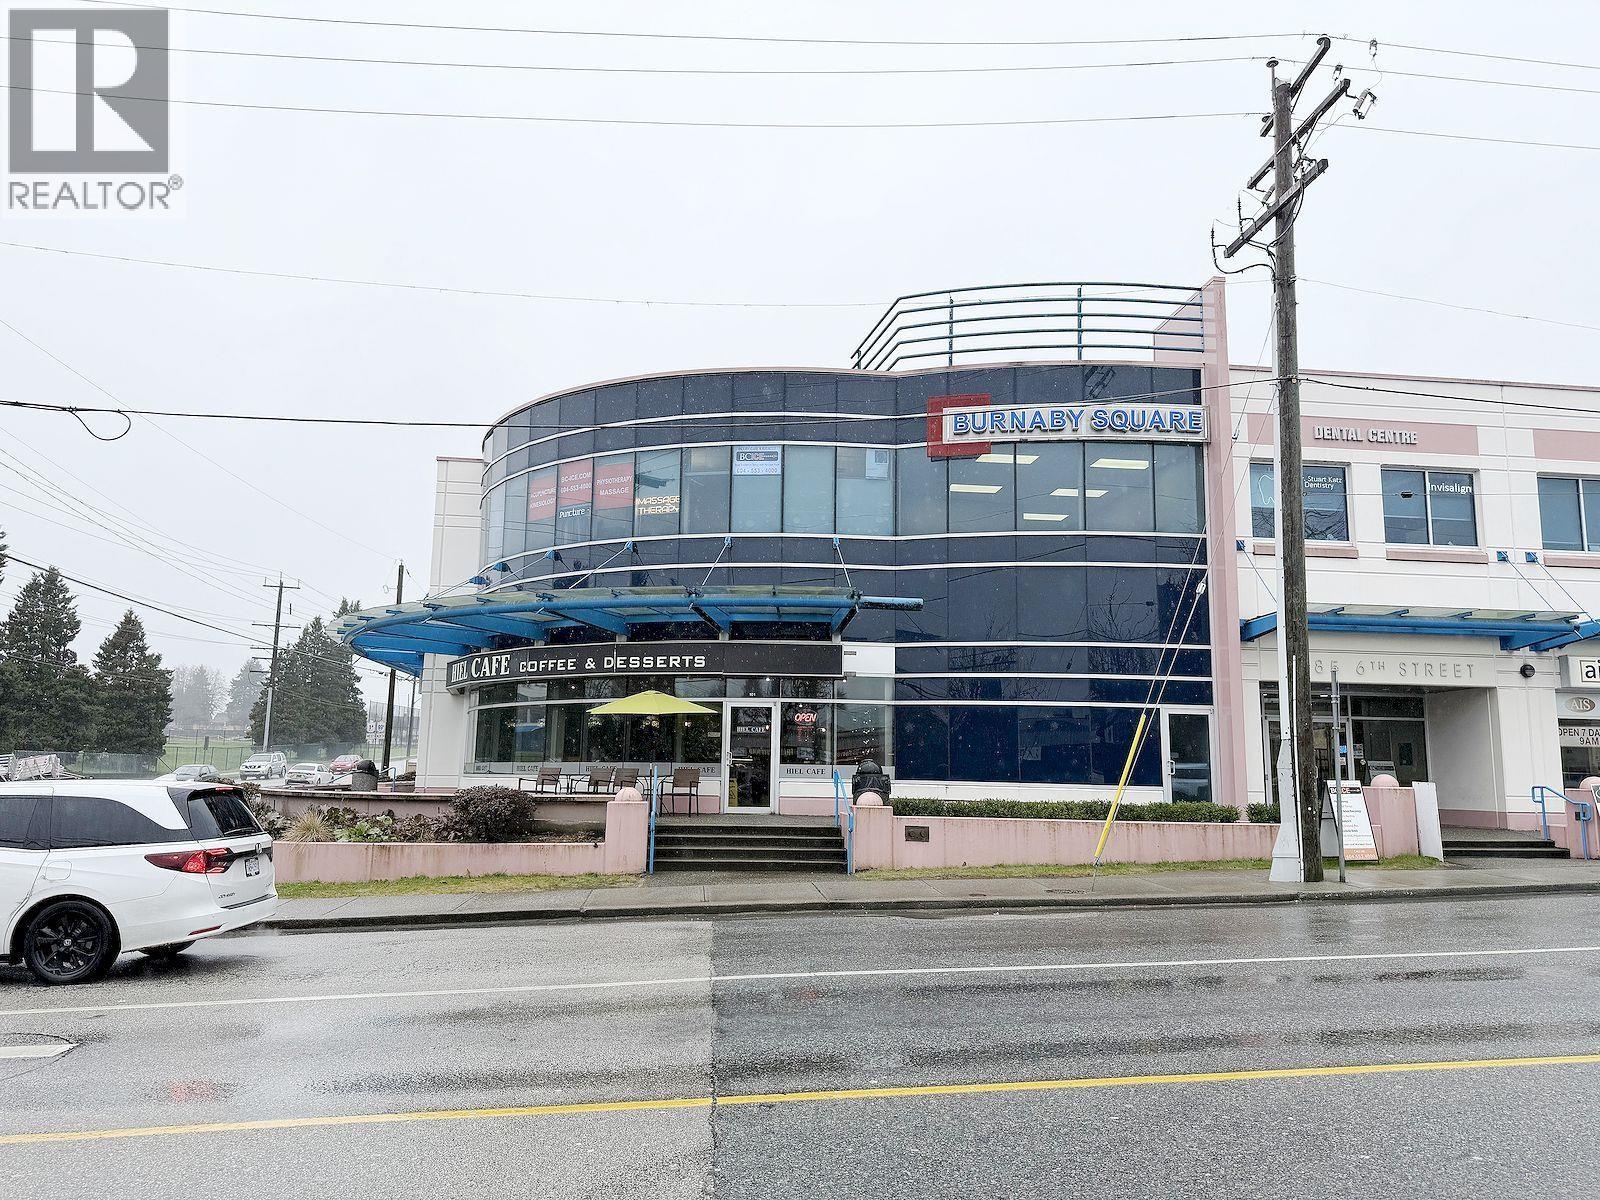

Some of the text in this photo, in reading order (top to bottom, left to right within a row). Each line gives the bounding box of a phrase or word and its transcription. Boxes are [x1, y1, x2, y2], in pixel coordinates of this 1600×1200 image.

[953, 409, 1204, 434] BURNABY SQUARE
[1314, 425, 1418, 445] DENTAL CENTRE
[1304, 481, 1335, 490] Dentistry
[599, 486, 630, 496] MASSAGE
[635, 495, 680, 505] MASSAGE
[638, 505, 680, 515] THERAPY
[451, 654, 706, 682] HIEL CAFE COFFEE & DESSERTS
[1398, 662, 1474, 678] STREET
[1571, 698, 1591, 711] AIS
[794, 713, 817, 722] OPEN
[1581, 728, 1586, 737] 7
[1589, 728, 1600, 737] DA
